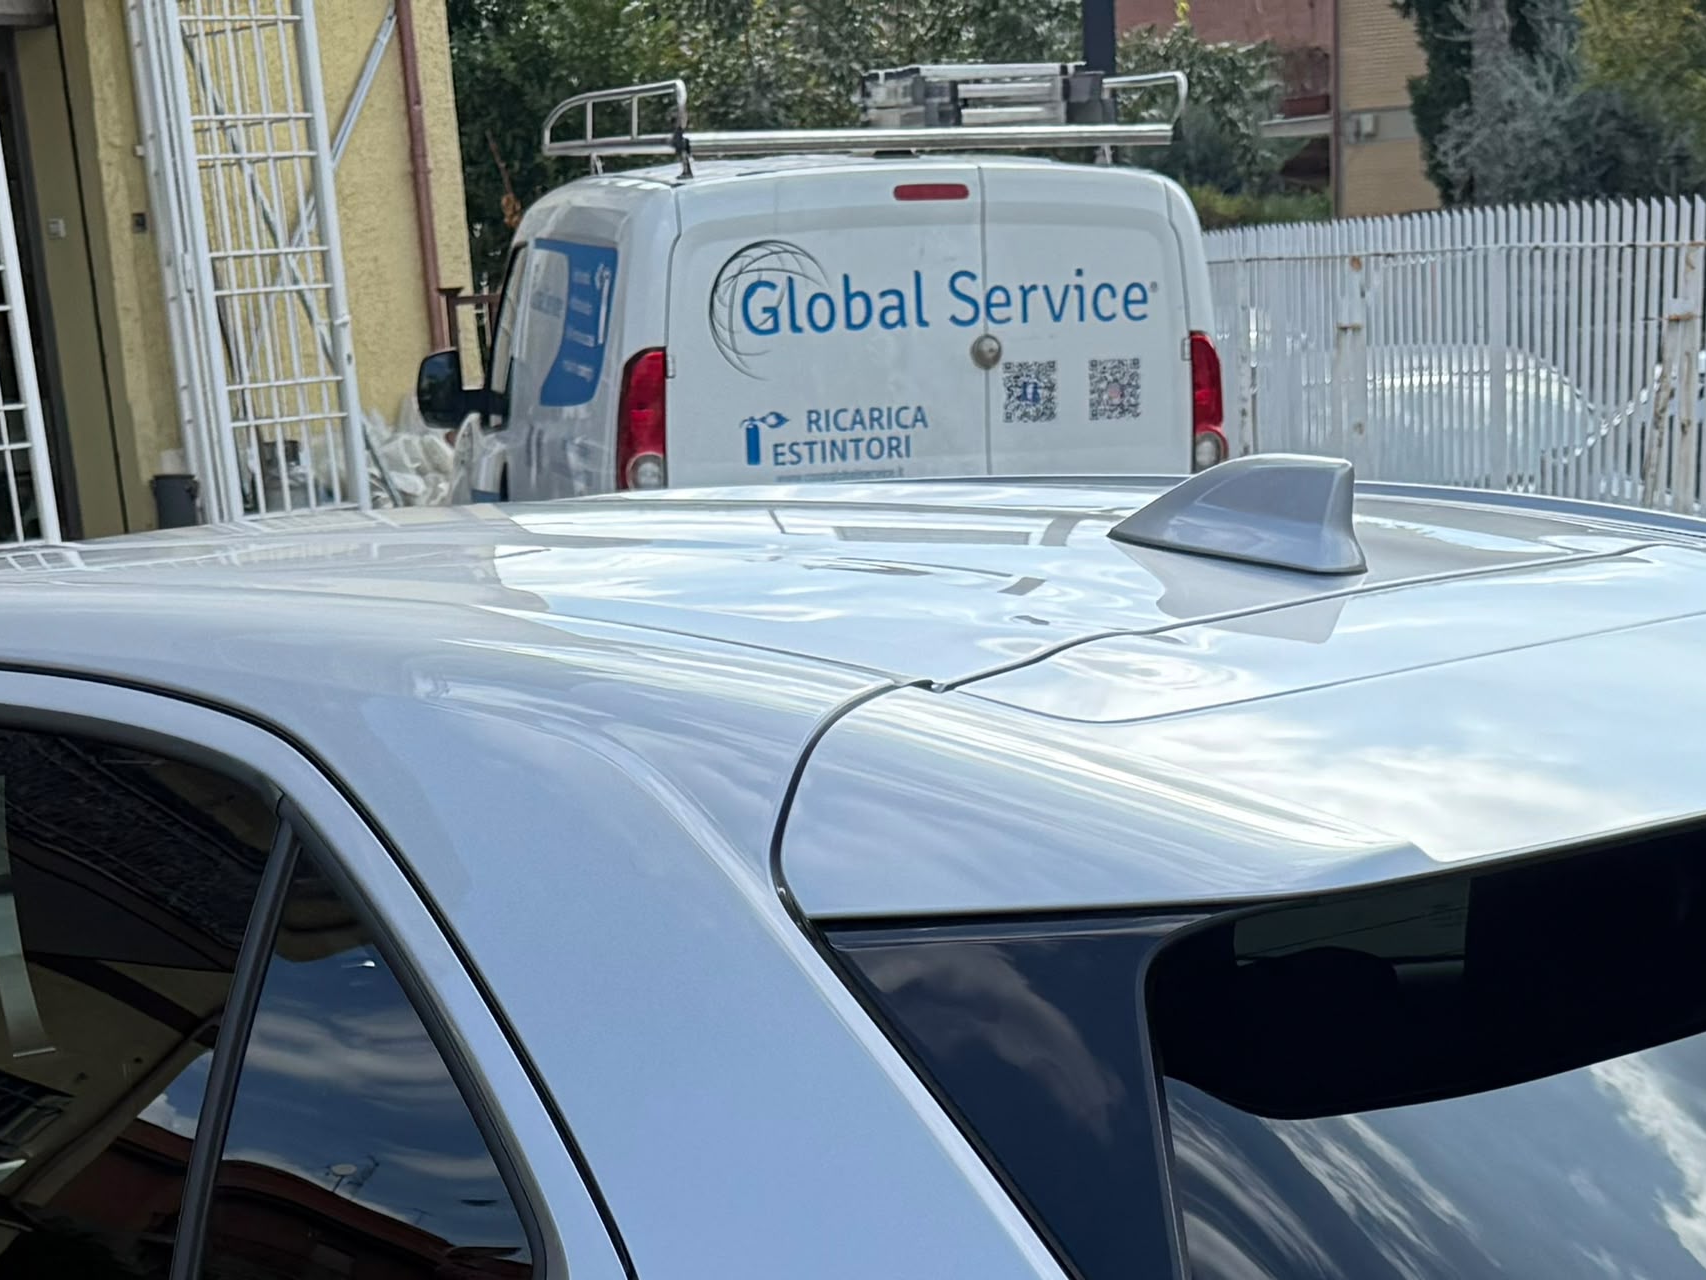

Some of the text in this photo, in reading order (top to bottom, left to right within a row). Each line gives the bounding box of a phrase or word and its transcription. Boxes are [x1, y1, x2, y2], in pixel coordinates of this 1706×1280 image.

[742, 270, 930, 336] Global
[806, 406, 929, 433] RICARICA
[772, 434, 912, 466] ESTINTORI
